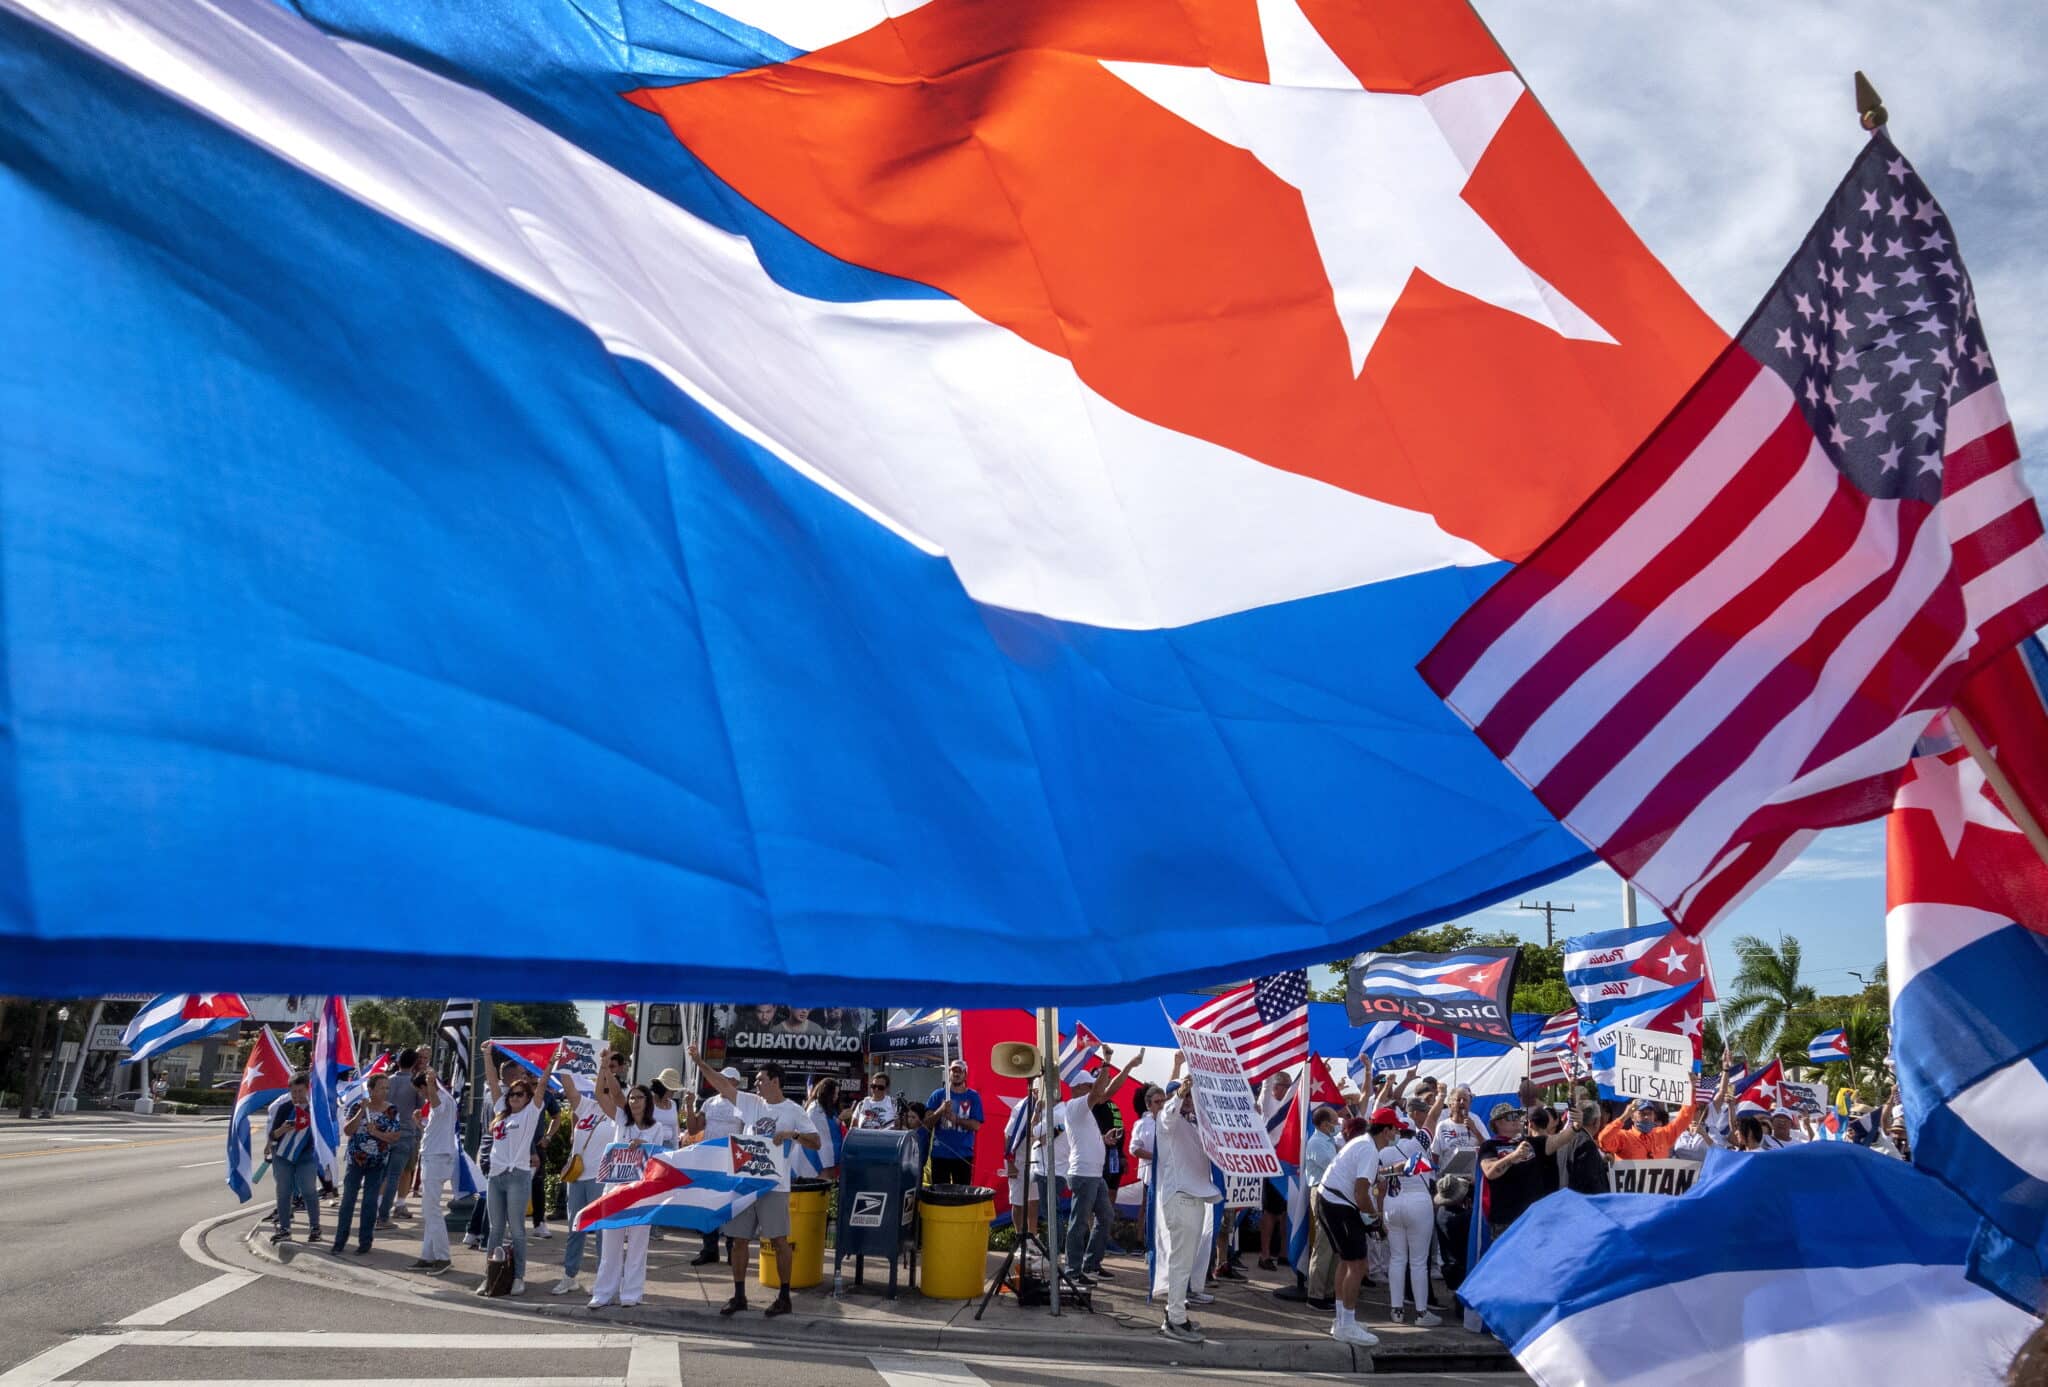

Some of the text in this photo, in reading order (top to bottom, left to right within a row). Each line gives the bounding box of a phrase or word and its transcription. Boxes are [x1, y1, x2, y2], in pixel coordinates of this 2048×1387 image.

[735, 1031, 860, 1052] CUBATONAZO
[1223, 1131, 1264, 1149] PCC!!!
[1218, 1151, 1278, 1174] ASESINO
